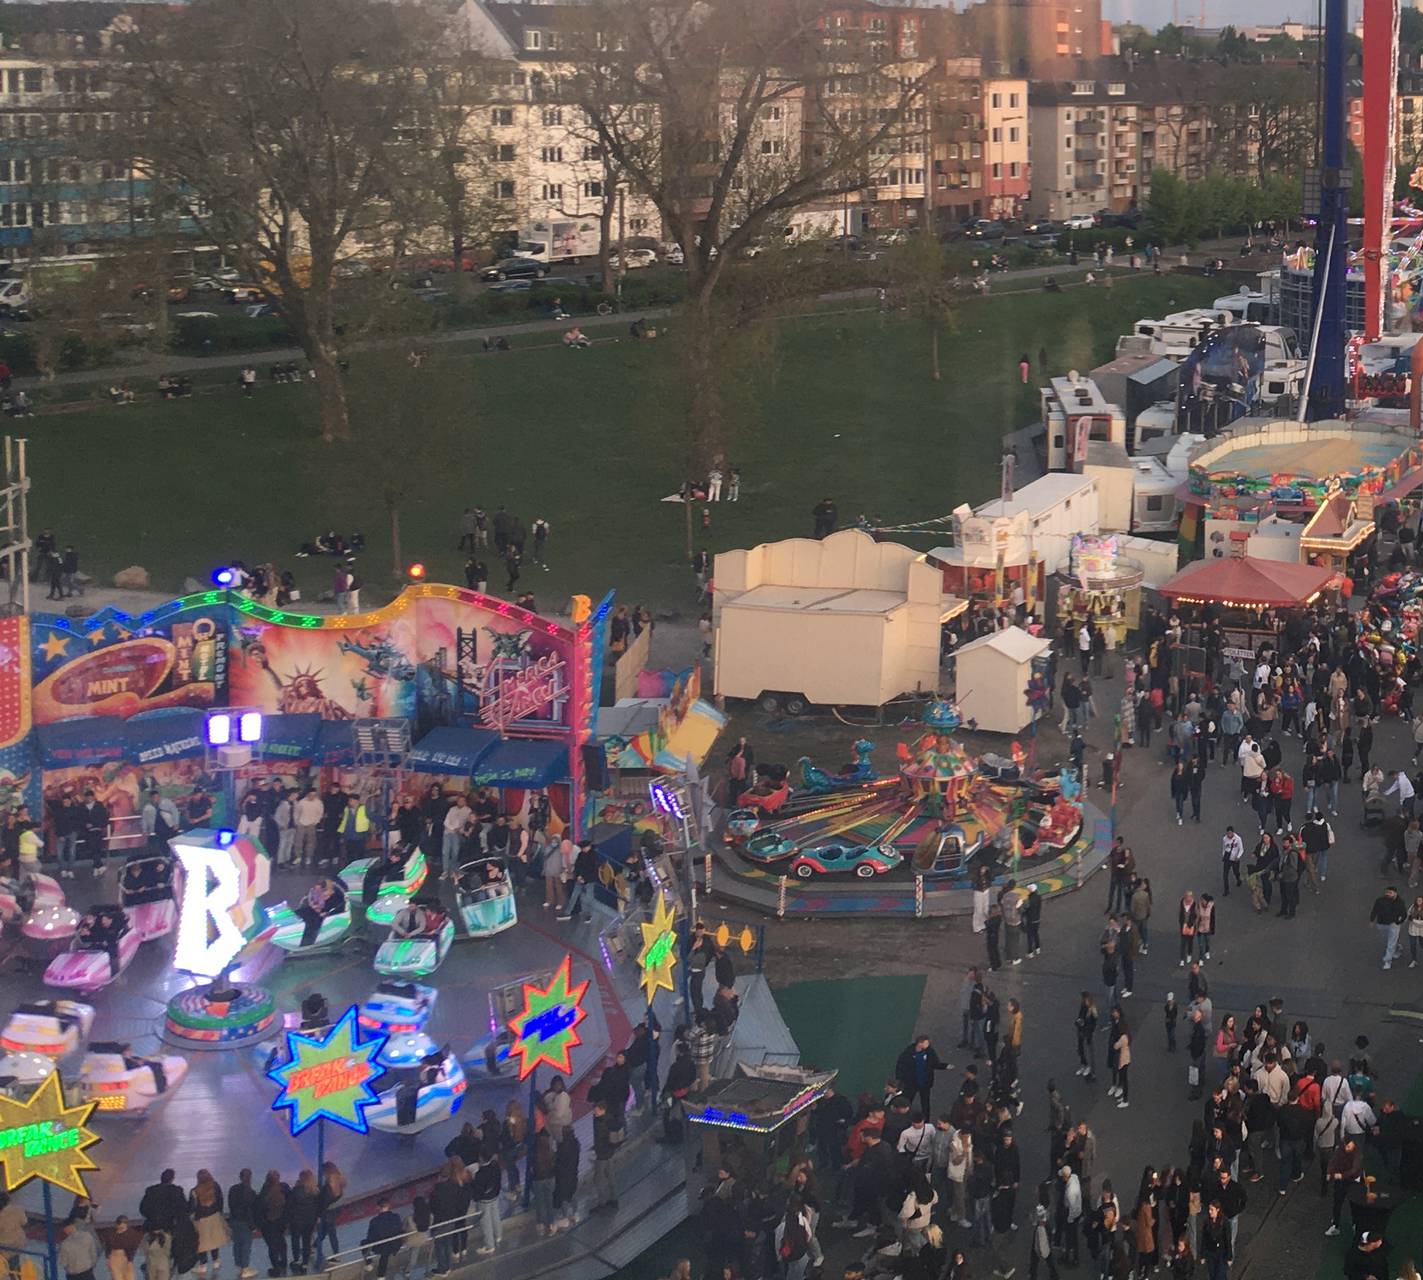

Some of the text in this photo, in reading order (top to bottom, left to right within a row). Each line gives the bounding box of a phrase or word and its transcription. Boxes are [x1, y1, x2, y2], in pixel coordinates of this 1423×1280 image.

[177, 636, 193, 681] MINT
[87, 677, 130, 697] MINT
[172, 844, 248, 977] B
[287, 1056, 348, 1095] BREAK
